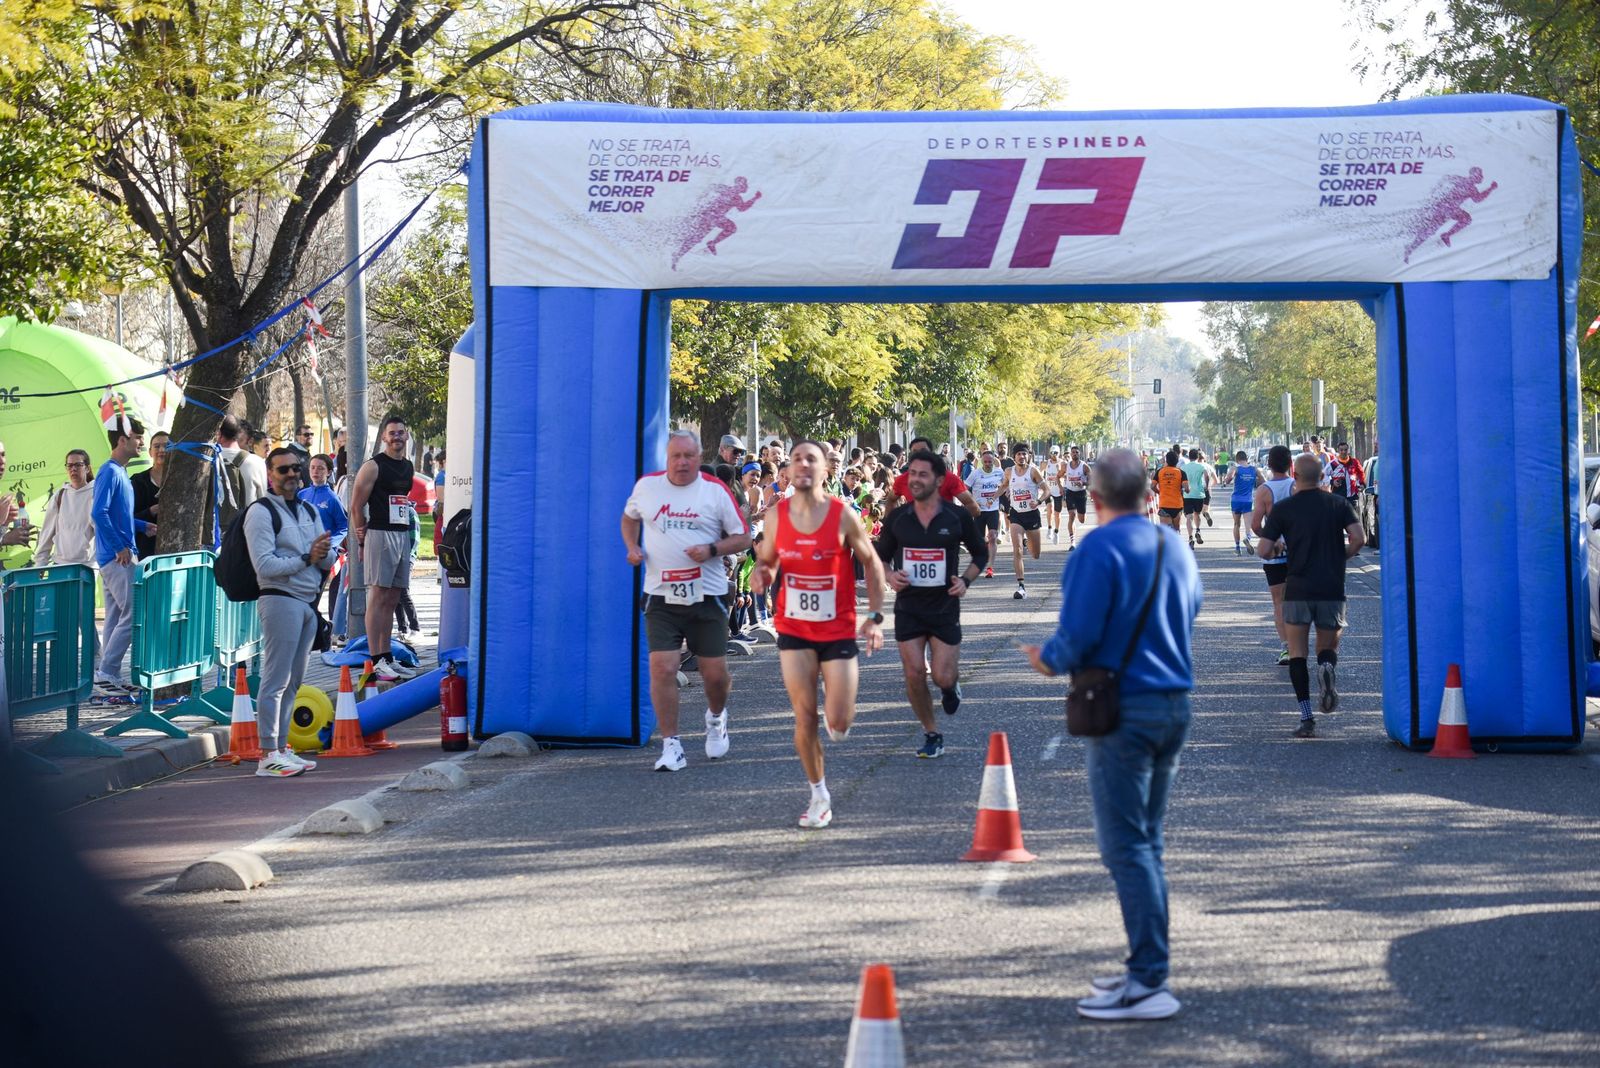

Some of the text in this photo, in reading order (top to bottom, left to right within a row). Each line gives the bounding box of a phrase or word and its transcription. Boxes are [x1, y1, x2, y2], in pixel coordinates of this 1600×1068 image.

[928, 136, 1147, 150] DEPORTESPINEDA
[1318, 131, 1423, 145] NO SE TRATA
[588, 139, 691, 151] NO SE TRATA
[1318, 147, 1341, 160] DE
[1345, 146, 1413, 160] CORRER
[588, 154, 611, 167] DE
[614, 154, 682, 167] CORRER
[588, 169, 691, 182] SE TRATA DE
[1319, 162, 1424, 176] SE TRATA DE
[1319, 178, 1387, 191] CORRER
[588, 185, 655, 198] CORRER
[588, 200, 645, 213] MEJOR
[1319, 194, 1377, 207] MEJOR
[8, 460, 46, 473] origen
[1018, 500, 1027, 509] 48
[659, 517, 699, 534] JEREZ
[912, 563, 936, 579] 186
[671, 582, 695, 598] 231
[800, 592, 820, 611] 88
